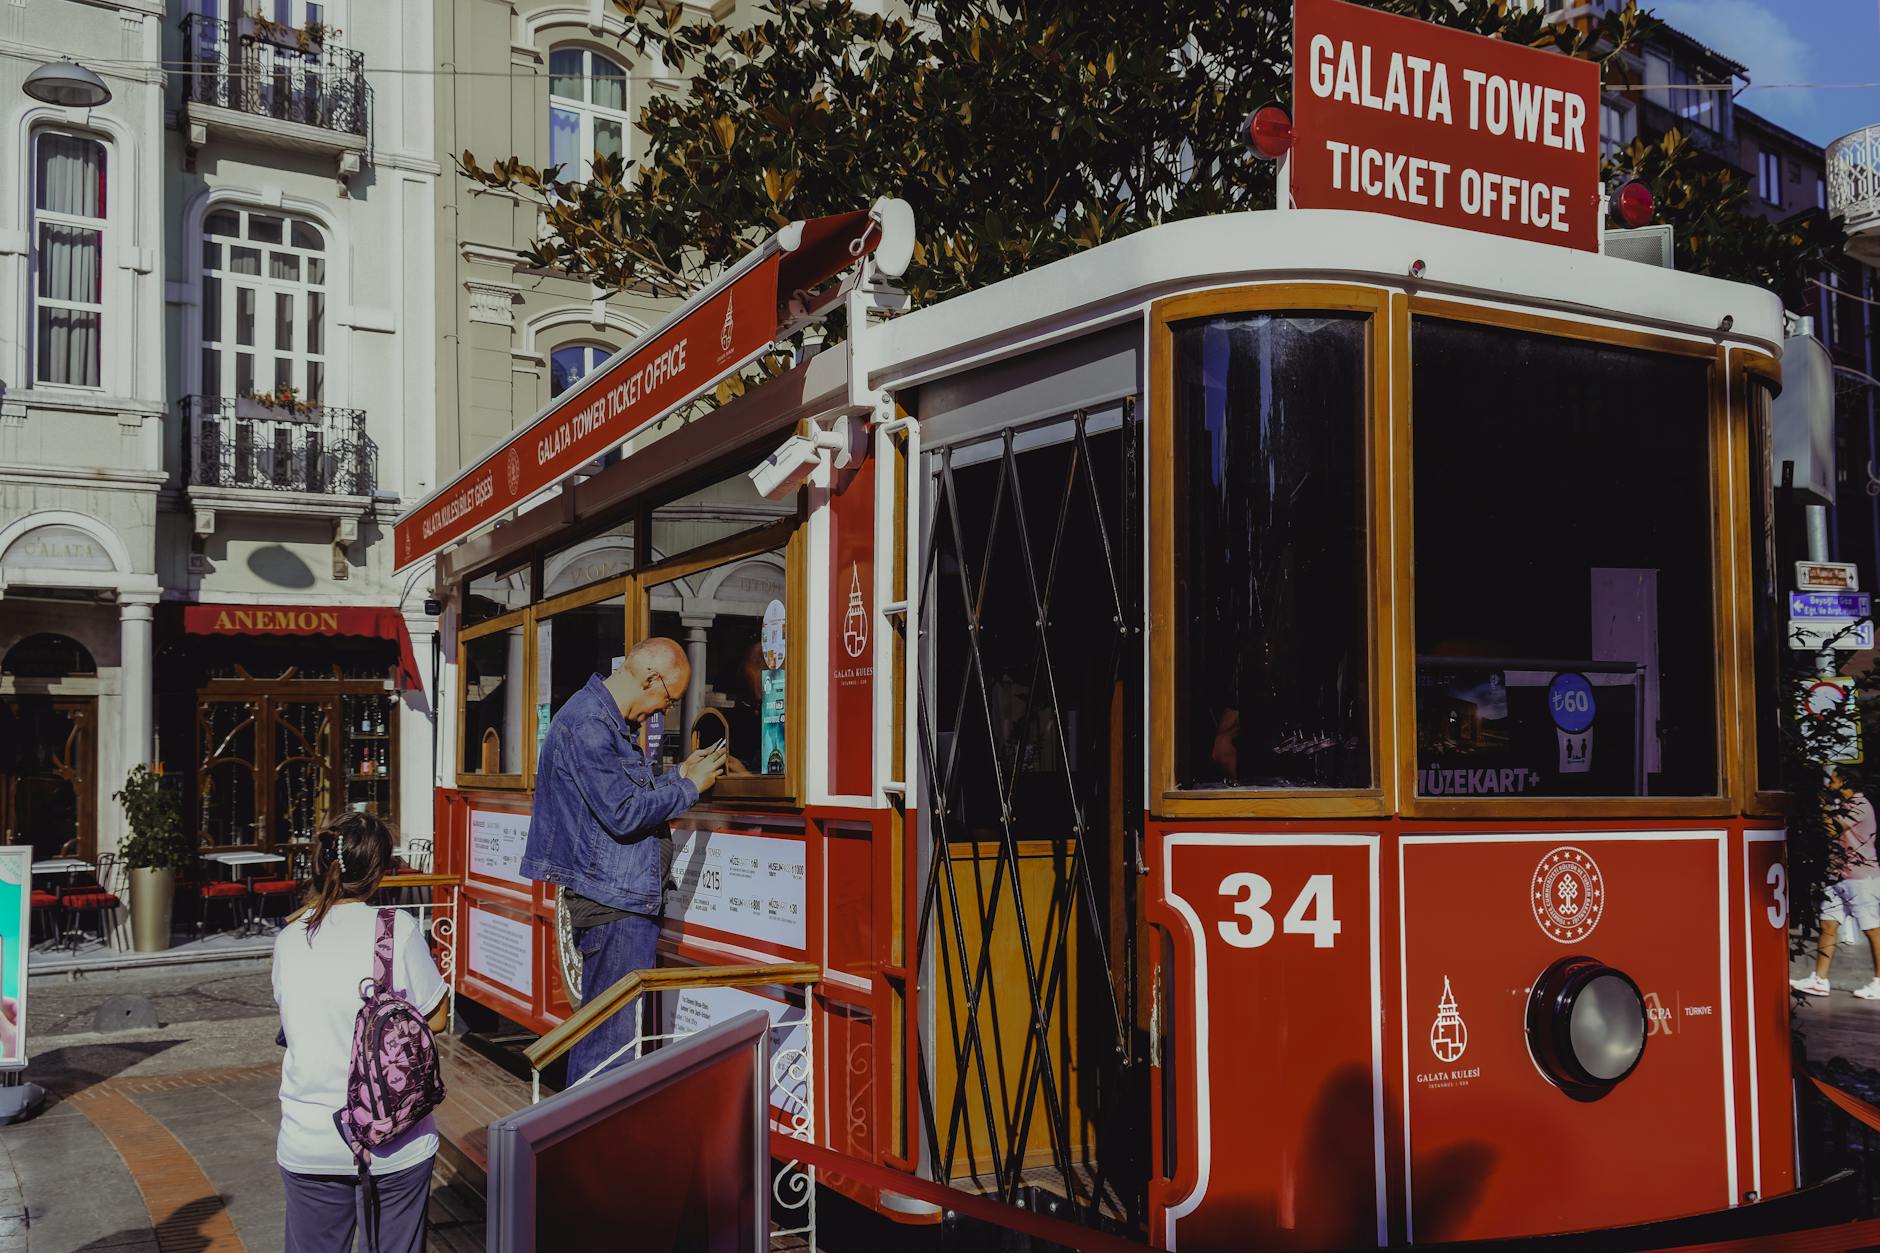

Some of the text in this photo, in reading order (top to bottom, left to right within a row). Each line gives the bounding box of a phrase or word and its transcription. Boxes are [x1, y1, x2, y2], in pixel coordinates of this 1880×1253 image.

[1309, 33, 1587, 154] GALATA TOWER
[1326, 140, 1571, 233] TICKET OFFICE
[537, 337, 688, 466] GALATA TOWER TICKET OFFICE
[422, 511, 442, 540] GALATA
[474, 469, 494, 507] GİŞESİ
[213, 610, 338, 630] ANEMON
[833, 668, 855, 678] GALATA
[1552, 690, 1588, 712] ₺60
[702, 870, 720, 890] ₺215
[1217, 872, 1342, 948] 34
[1416, 1067, 1480, 1083] GALATA KULESİ
